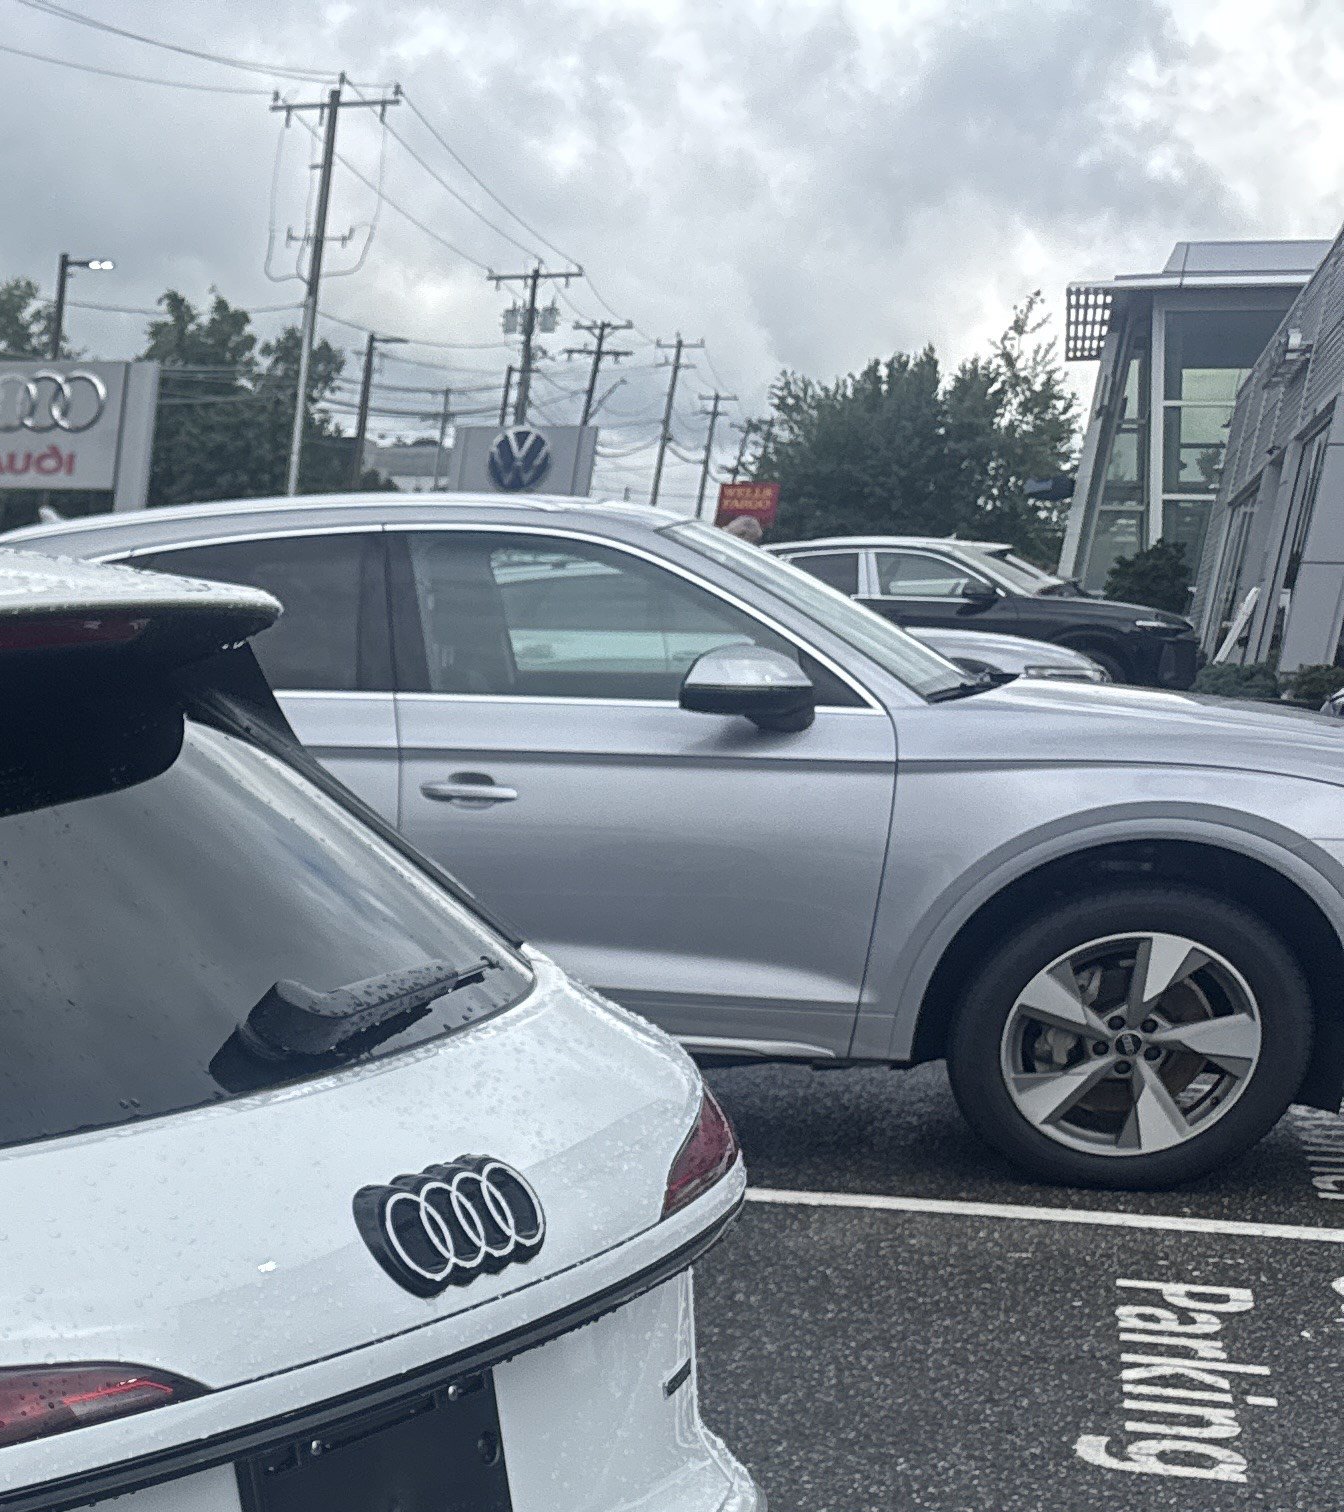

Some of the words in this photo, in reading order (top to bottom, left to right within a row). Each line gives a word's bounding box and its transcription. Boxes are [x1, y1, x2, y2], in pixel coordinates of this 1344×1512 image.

[723, 485, 772, 498] WELLS
[721, 499, 772, 511] FARGO
[1072, 1277, 1279, 1484] Parking
